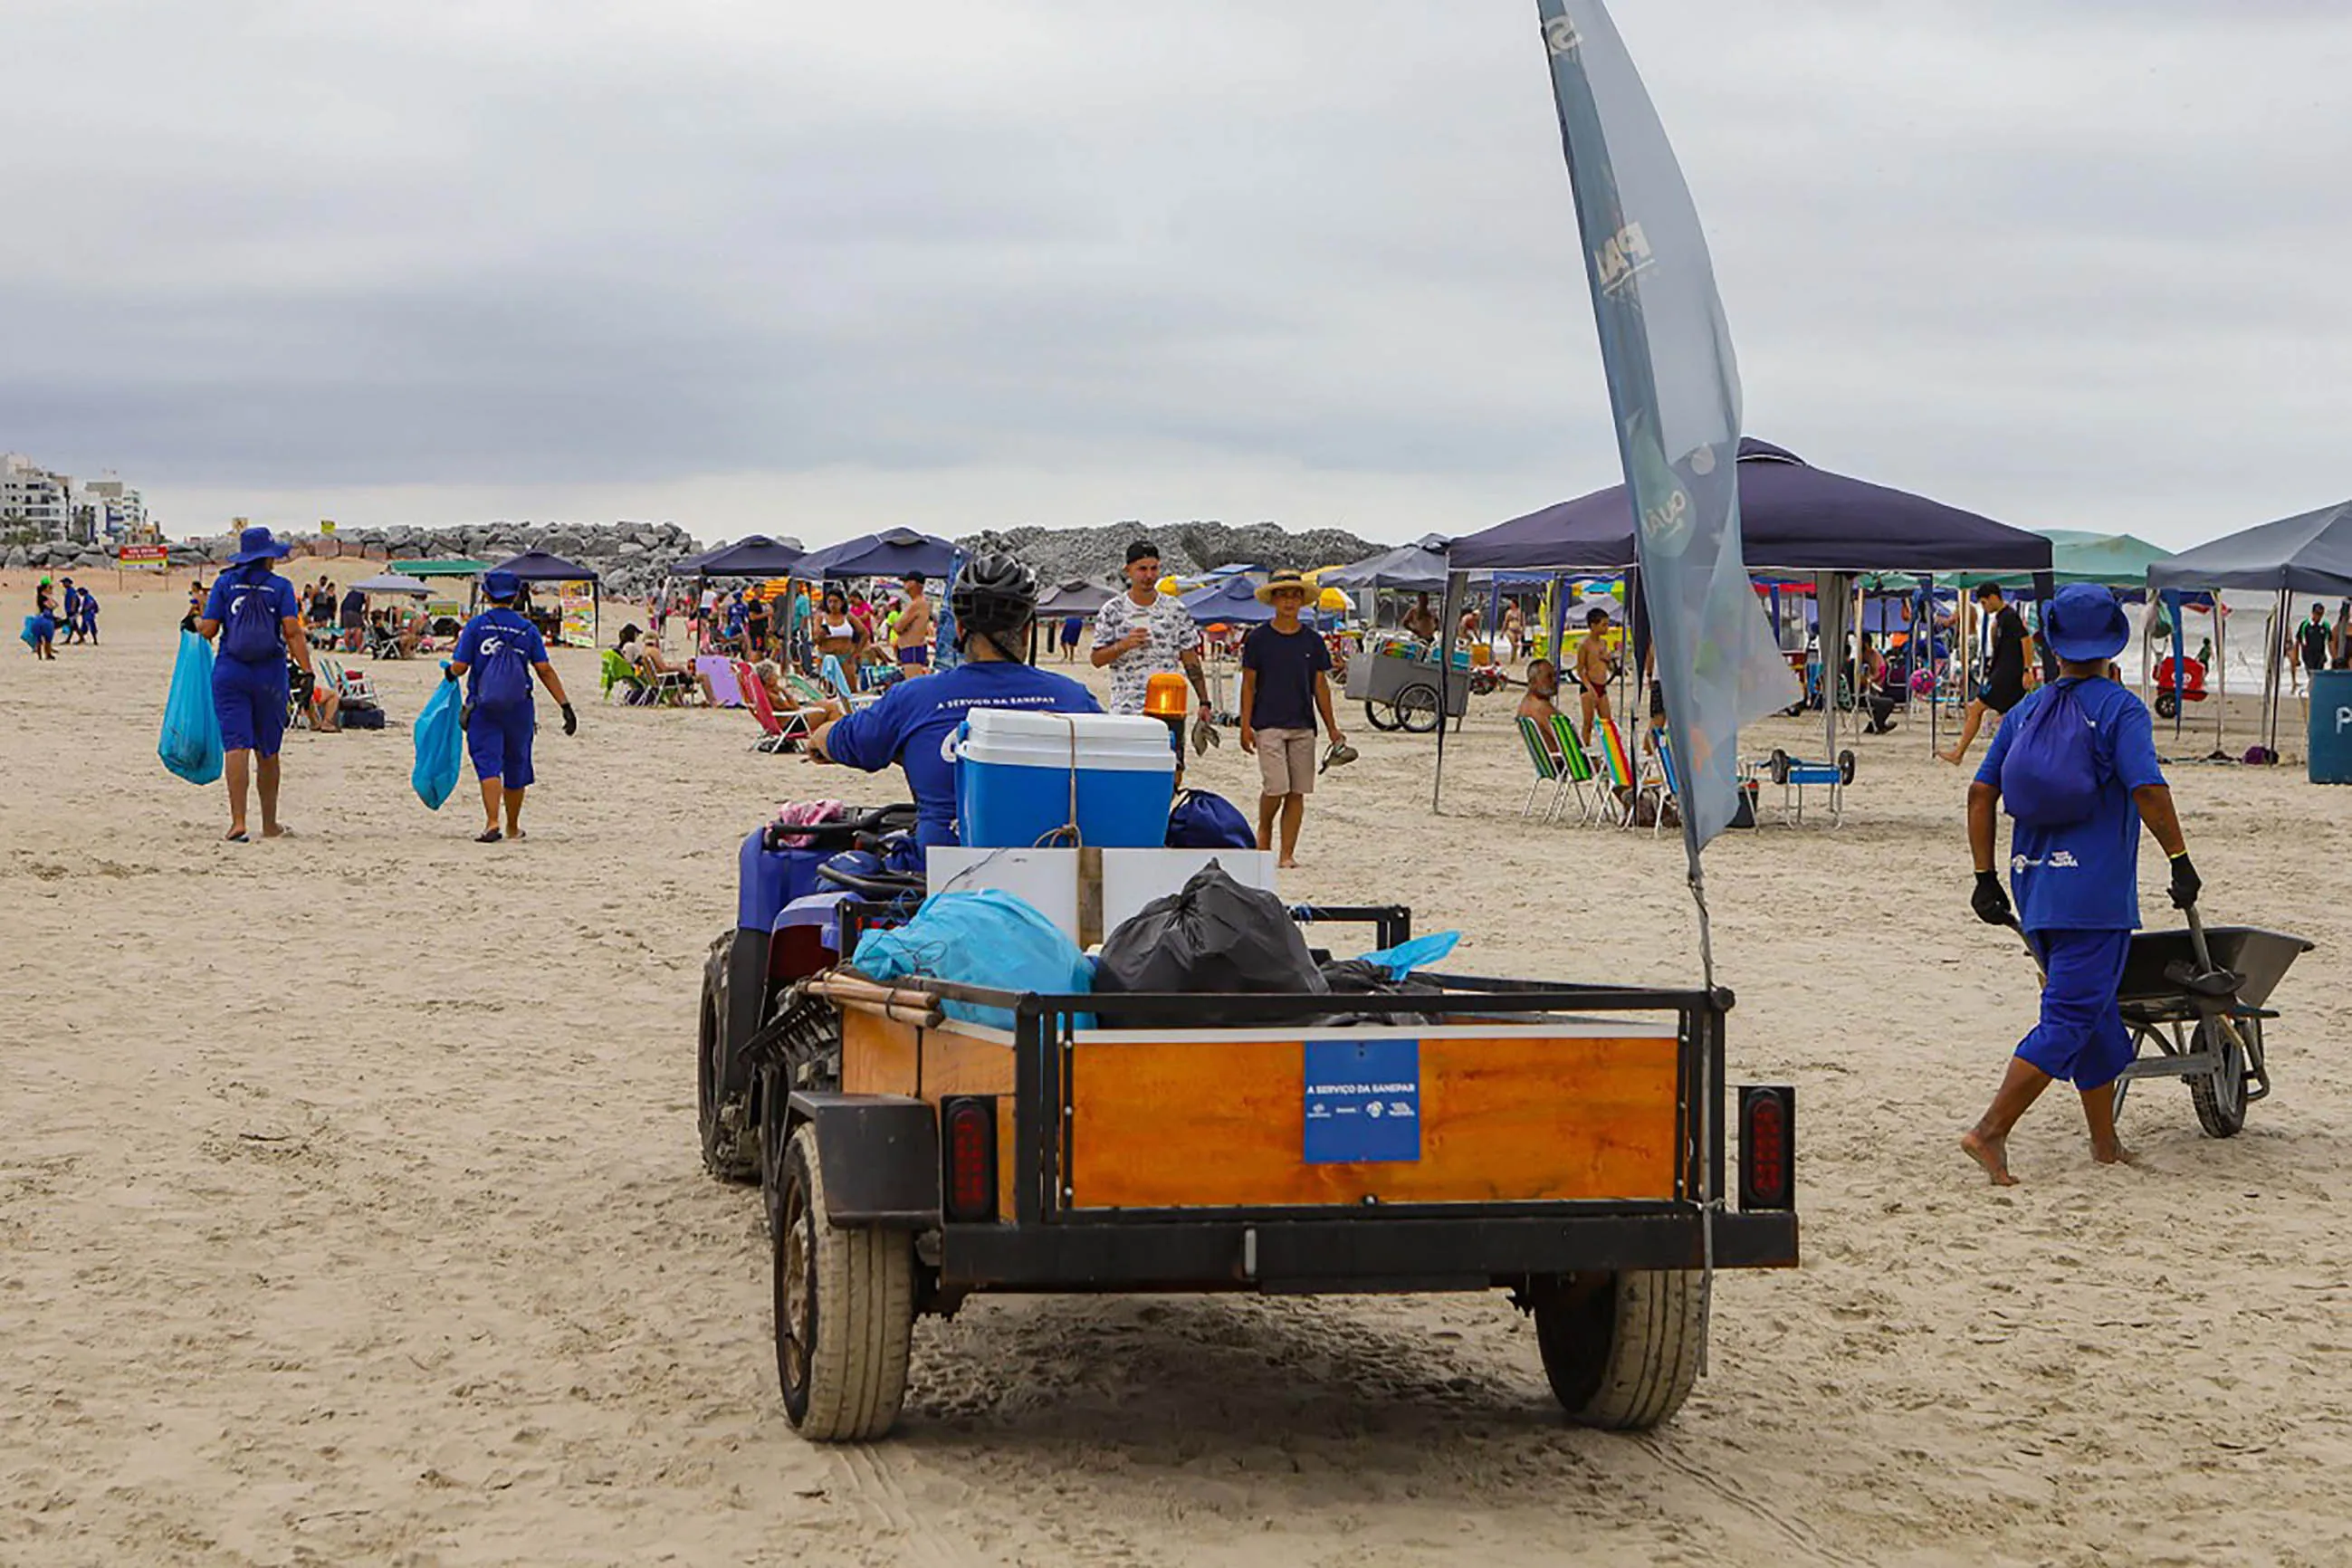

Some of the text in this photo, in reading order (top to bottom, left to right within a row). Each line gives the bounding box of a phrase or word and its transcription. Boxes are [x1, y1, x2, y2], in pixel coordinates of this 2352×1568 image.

[936, 702, 945, 710] A
[1306, 1083, 1415, 1095] A SERVIÇO DA SANEPAR
